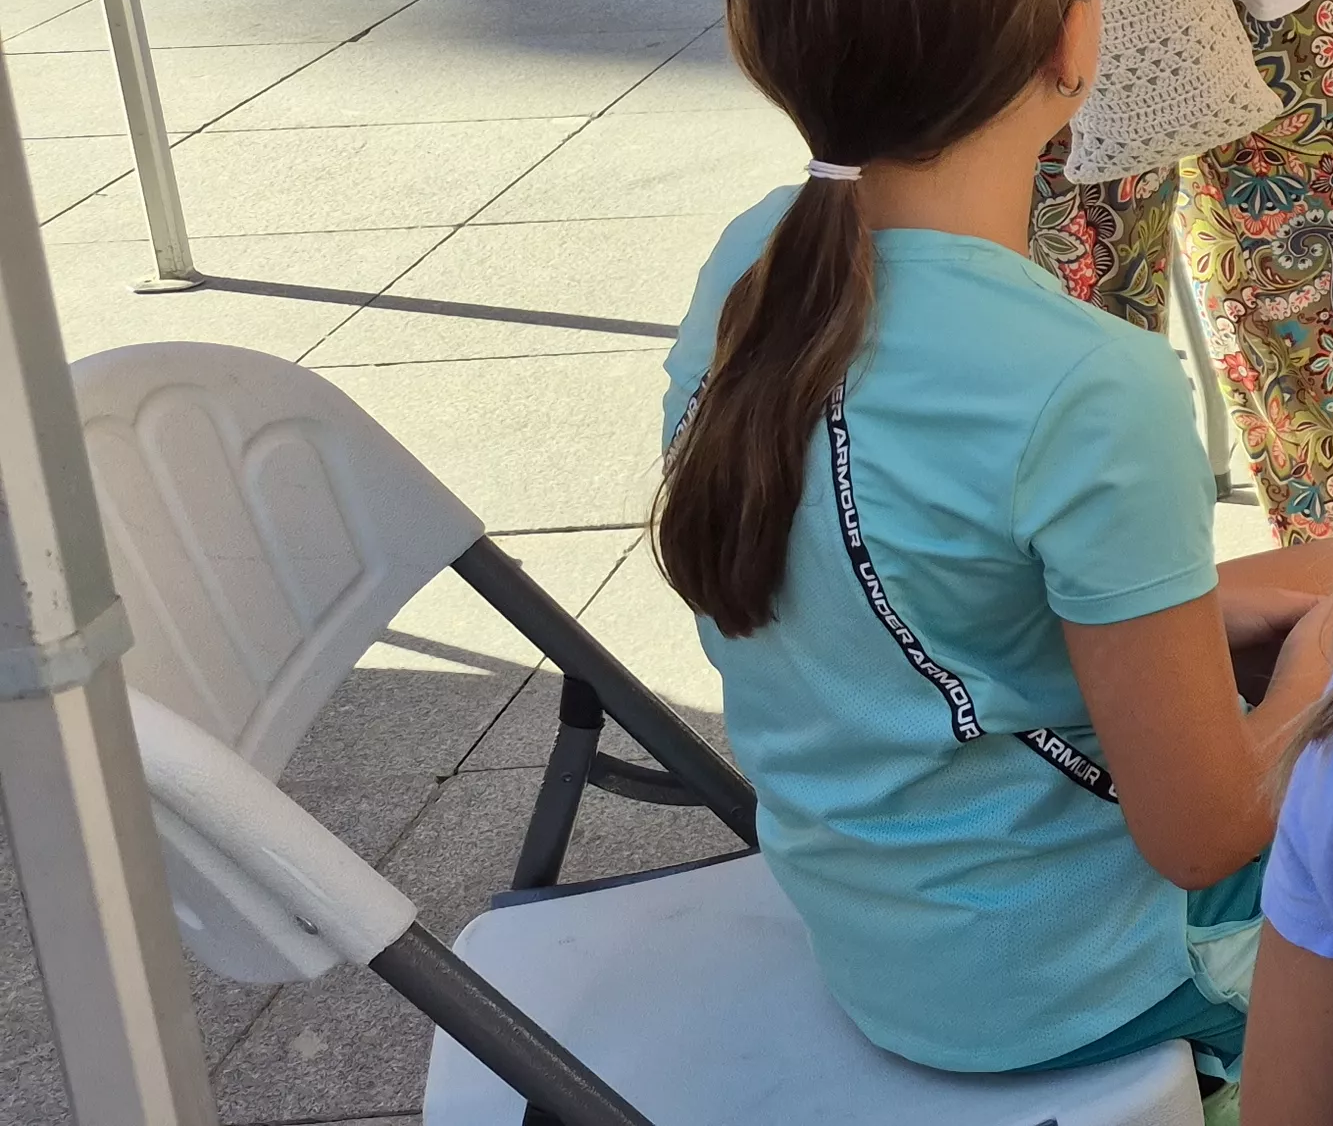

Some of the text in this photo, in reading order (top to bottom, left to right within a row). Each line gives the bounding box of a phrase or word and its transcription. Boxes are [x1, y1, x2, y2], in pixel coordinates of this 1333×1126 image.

[832, 427, 862, 548] ARMOUR
[859, 561, 980, 741] UNDER ARMOUR
